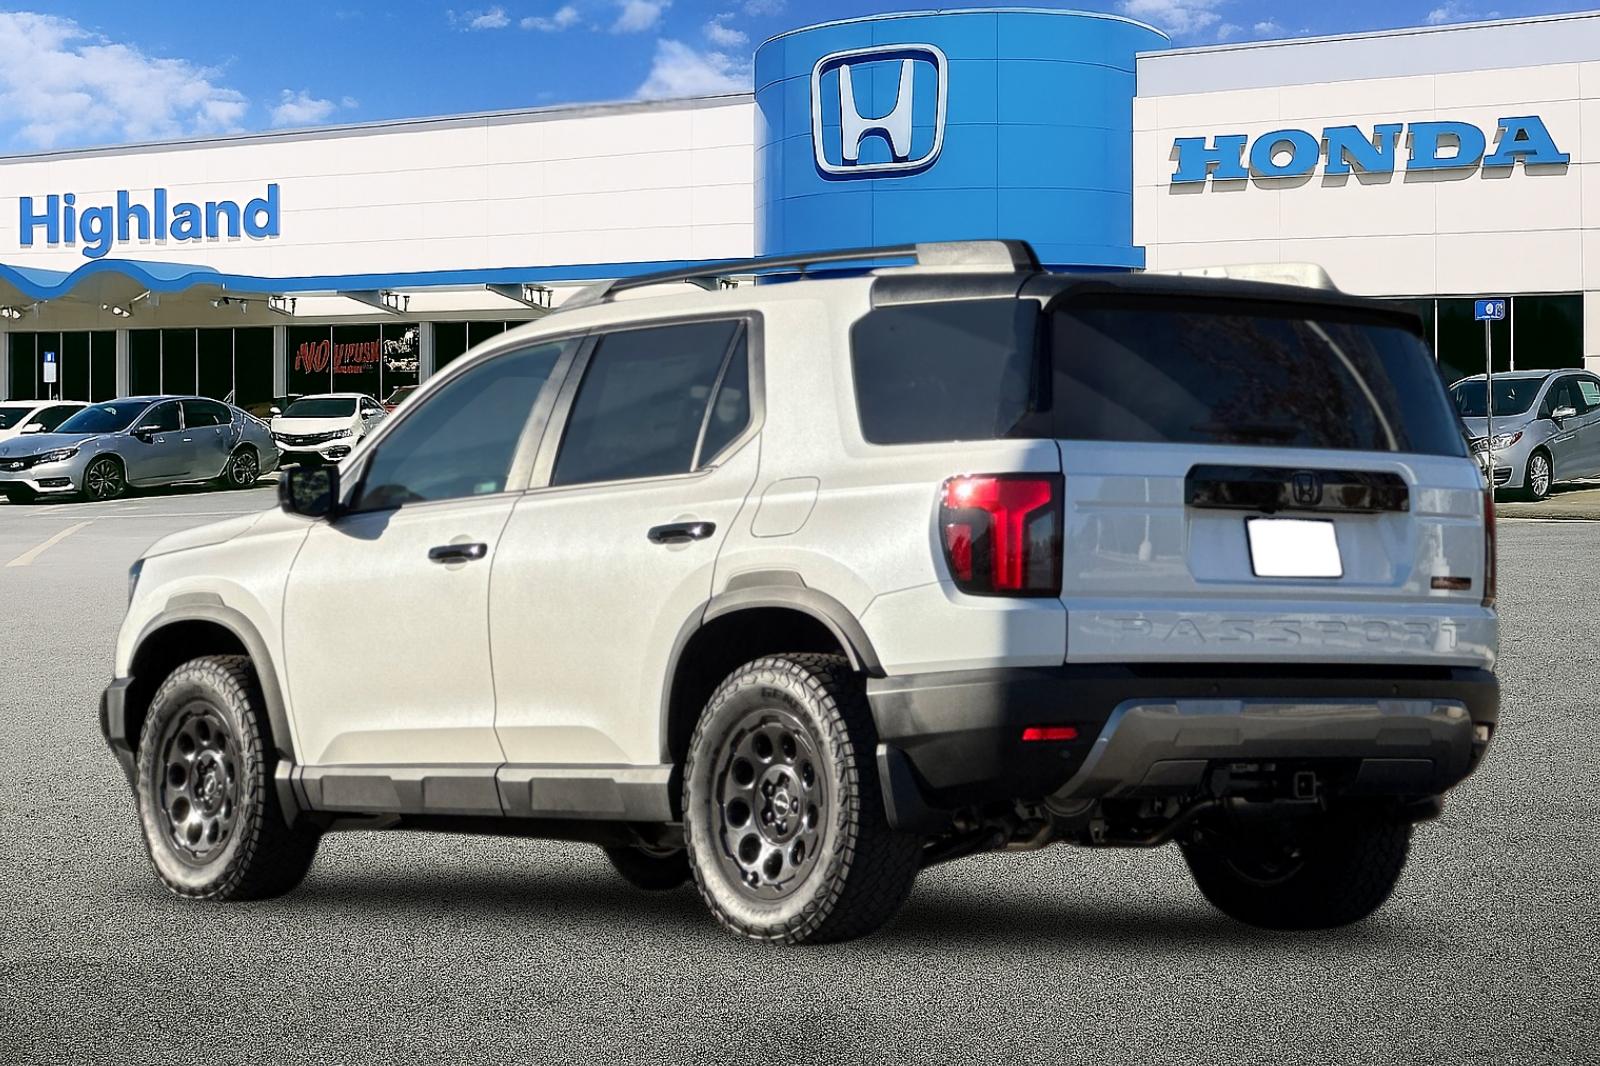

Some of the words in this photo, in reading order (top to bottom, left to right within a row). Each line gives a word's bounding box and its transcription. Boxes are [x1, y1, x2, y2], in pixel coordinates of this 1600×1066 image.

[1170, 115, 1571, 186] HONDA
[18, 182, 281, 258] Highland
[1113, 617, 1467, 650] PASSPORT
